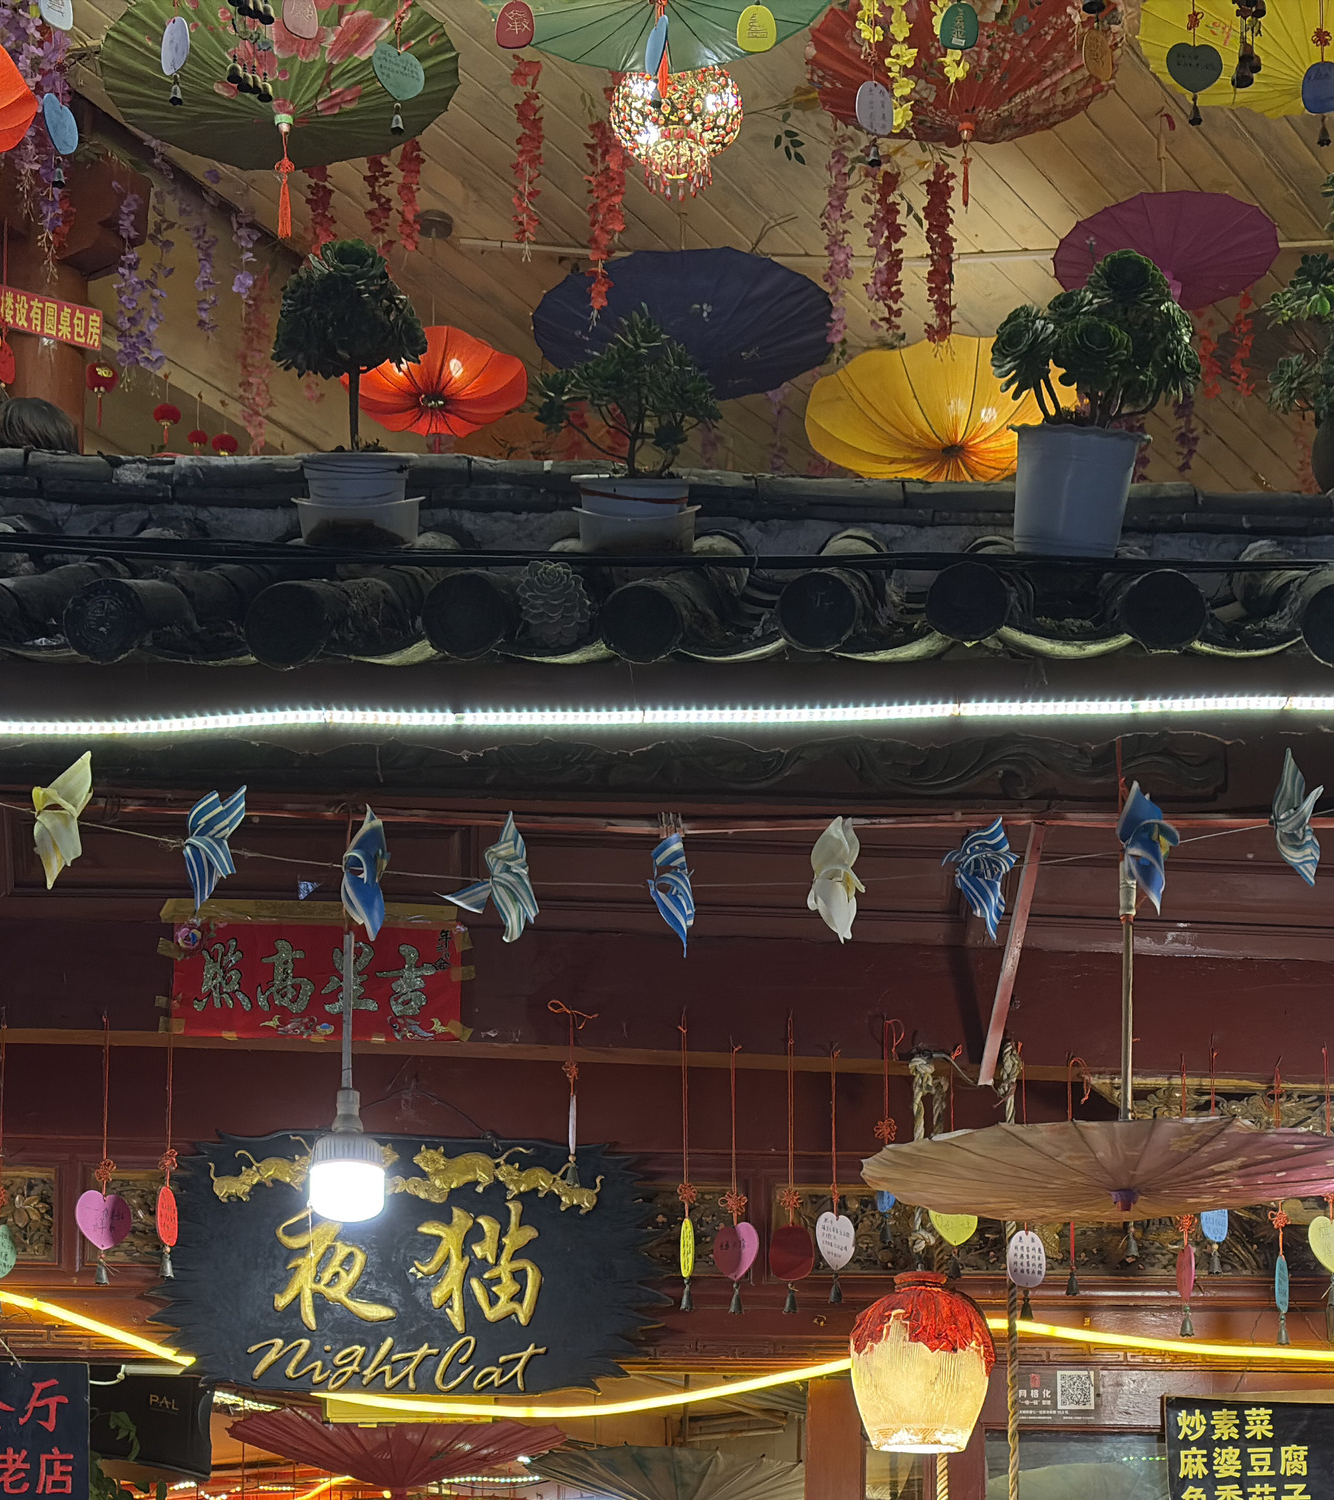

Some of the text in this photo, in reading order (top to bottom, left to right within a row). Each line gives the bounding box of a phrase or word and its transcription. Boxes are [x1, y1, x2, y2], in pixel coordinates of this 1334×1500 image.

[274, 1200, 545, 1334] 夜猫
[246, 1335, 548, 1393] Night Cat
[1177, 1407, 1274, 1441] 炒素菜
[1178, 1444, 1309, 1479] 麻婆豆腐
